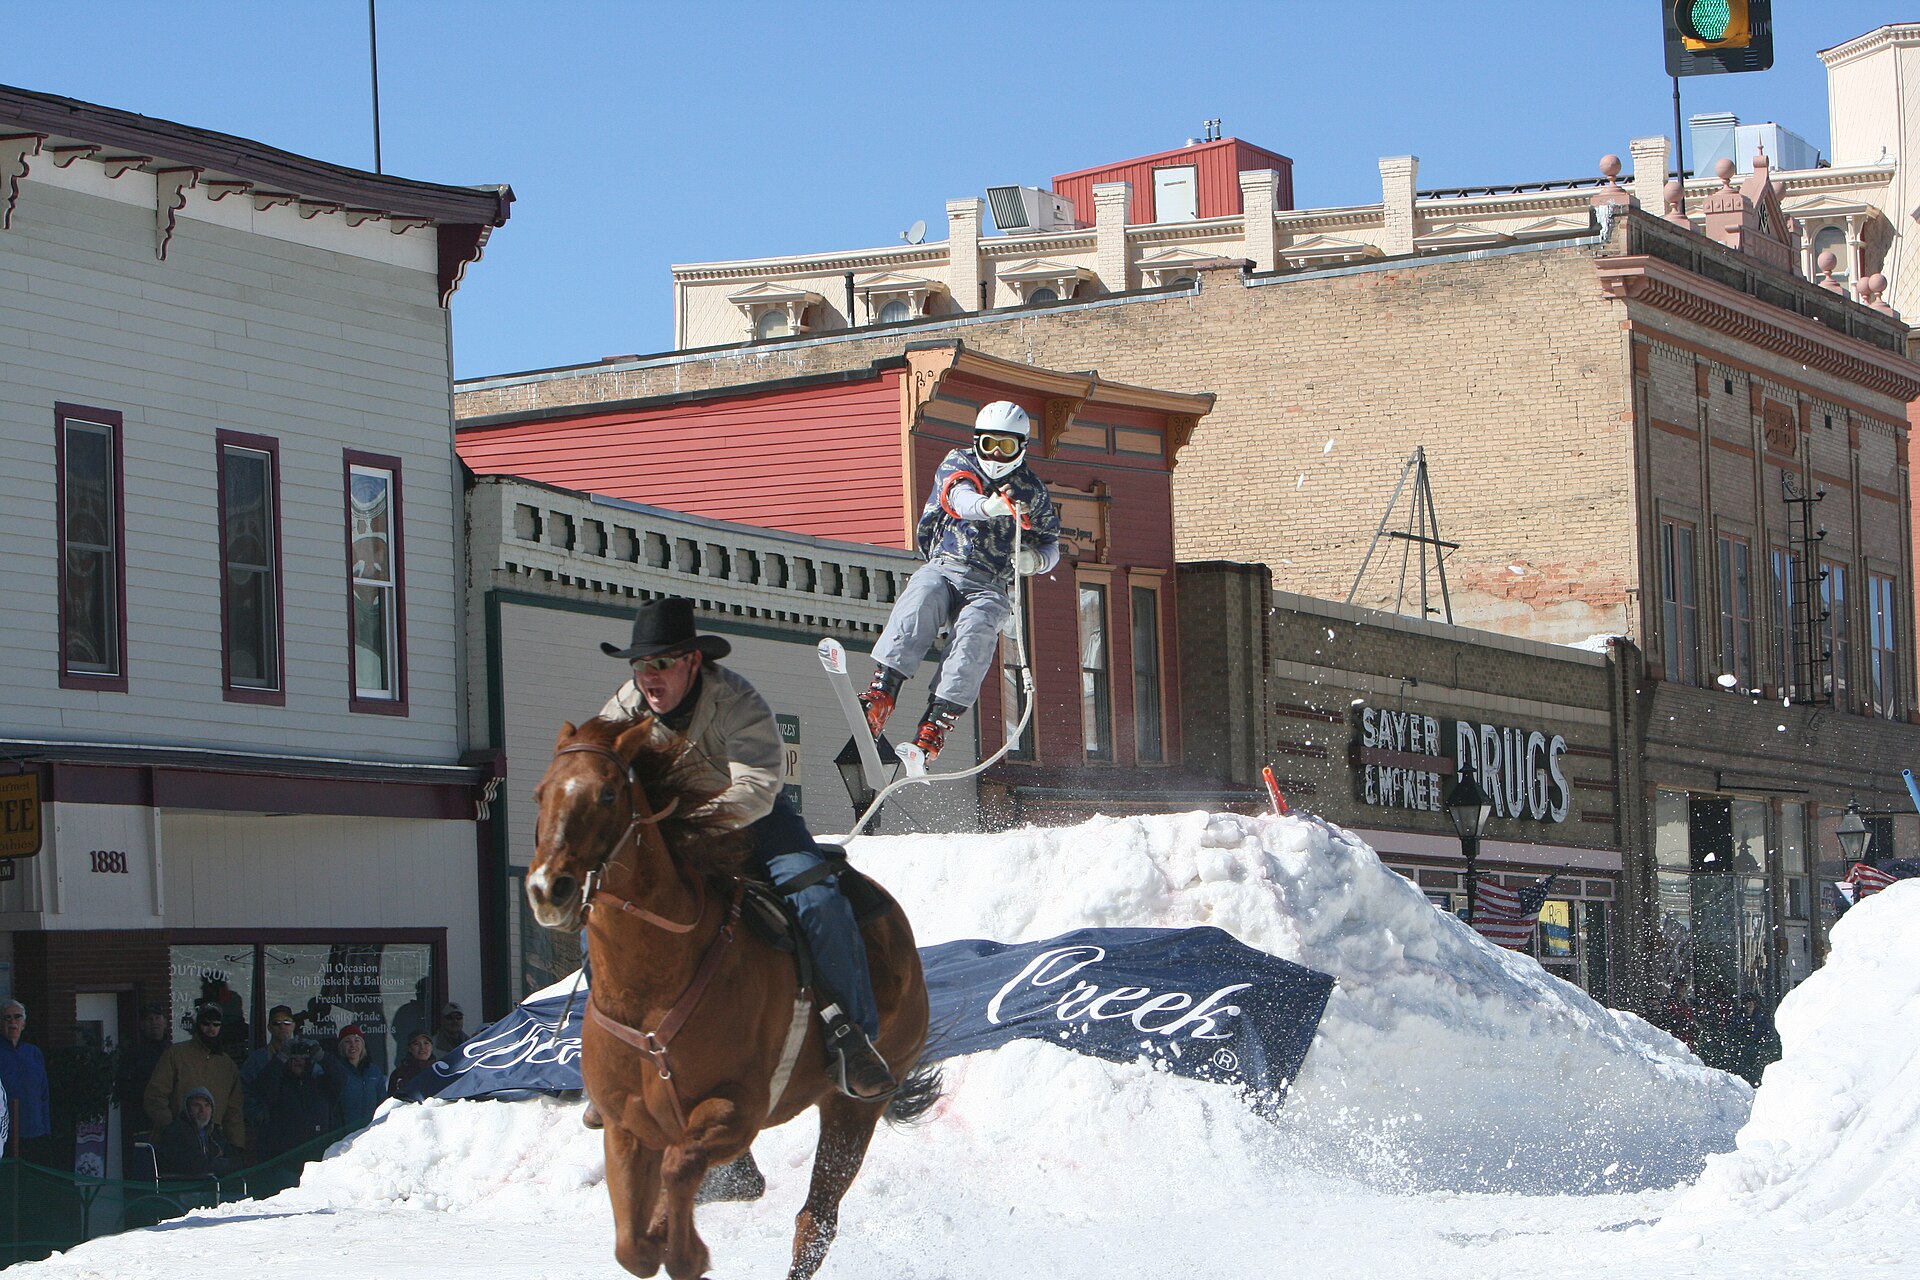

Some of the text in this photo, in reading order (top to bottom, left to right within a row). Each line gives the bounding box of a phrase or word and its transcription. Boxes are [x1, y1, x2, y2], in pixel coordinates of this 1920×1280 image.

[1363, 707, 1440, 757] SAYER
[1456, 720, 1570, 823] DRUGS
[0, 798, 34, 833] EE
[90, 850, 129, 873] 1881
[318, 962, 378, 974] All Occasion
[291, 975, 405, 988] Gift Baskets & Balloons
[315, 993, 383, 1004] Fresh Flowers
[987, 945, 1252, 1041] Creek
[317, 1011, 381, 1023] Locally Made
[359, 1023, 397, 1034] Candles
